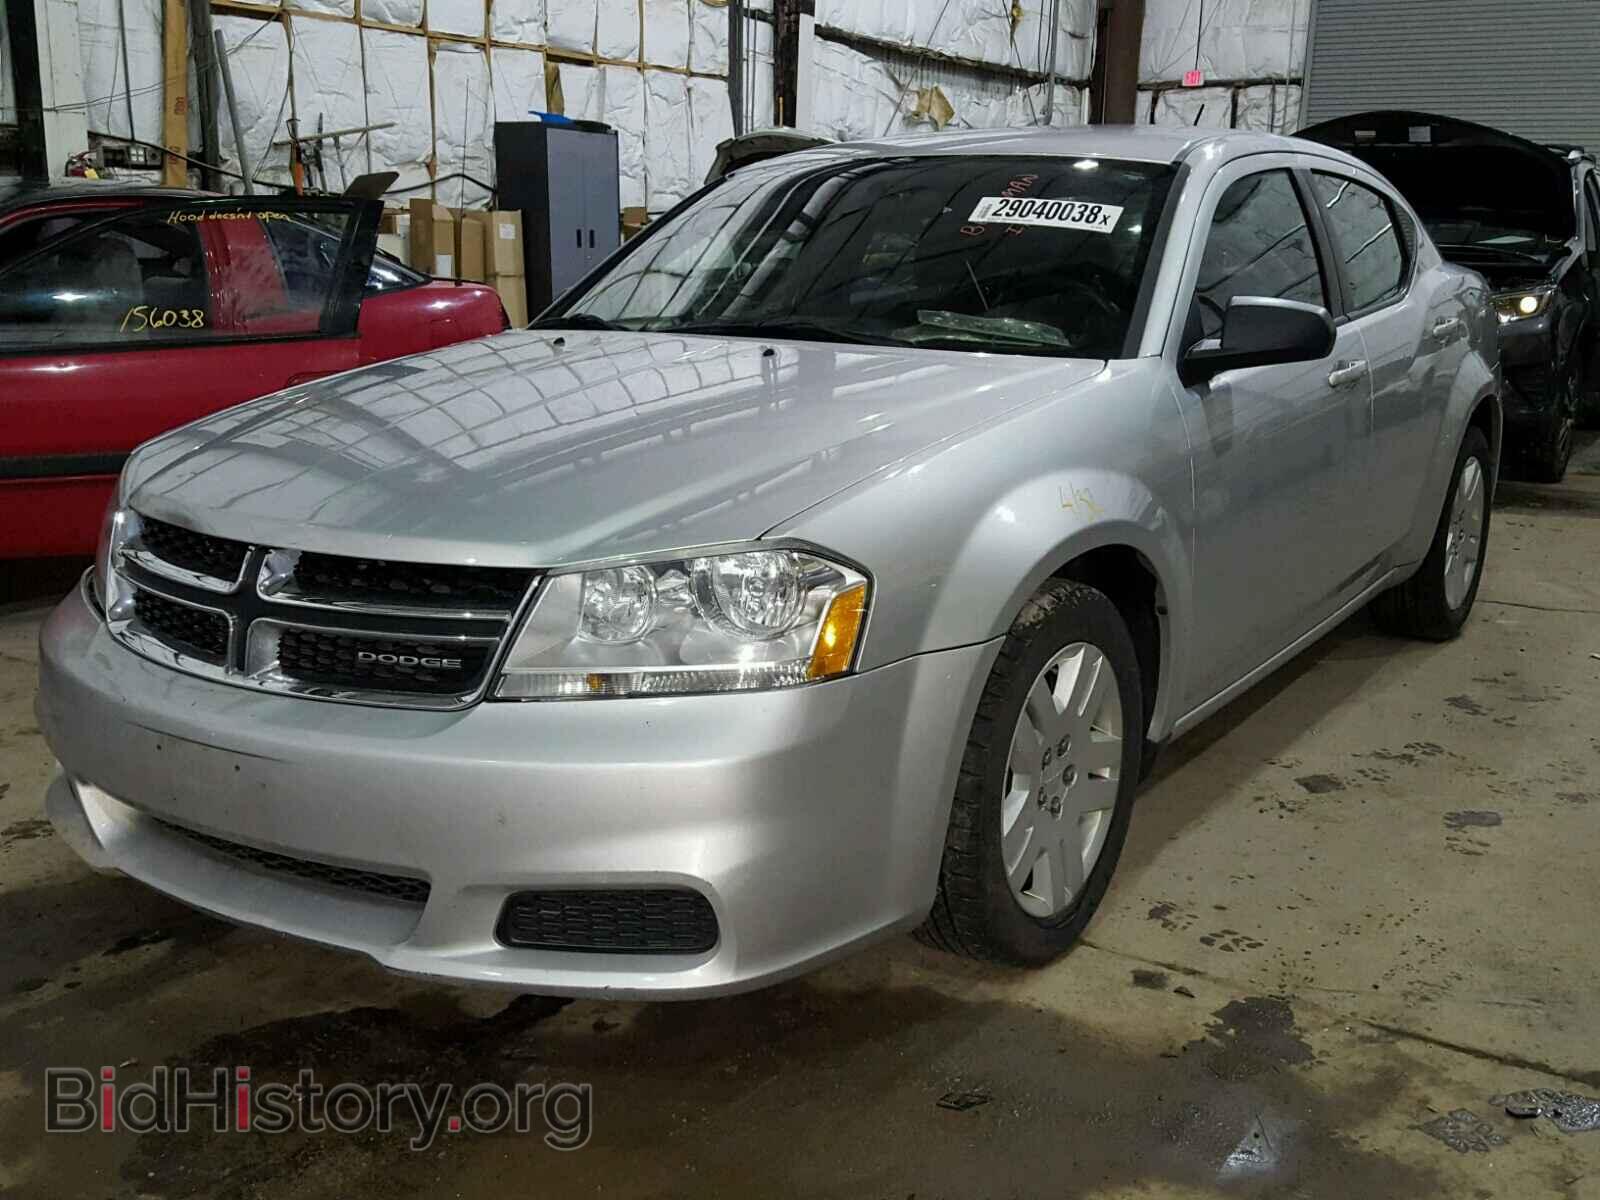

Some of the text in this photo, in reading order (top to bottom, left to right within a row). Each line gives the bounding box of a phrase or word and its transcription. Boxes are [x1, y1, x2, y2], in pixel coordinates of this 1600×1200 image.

[167, 209, 205, 224] Hood
[257, 211, 291, 223] open
[120, 305, 204, 332] 156038
[358, 651, 462, 668] DODGE
